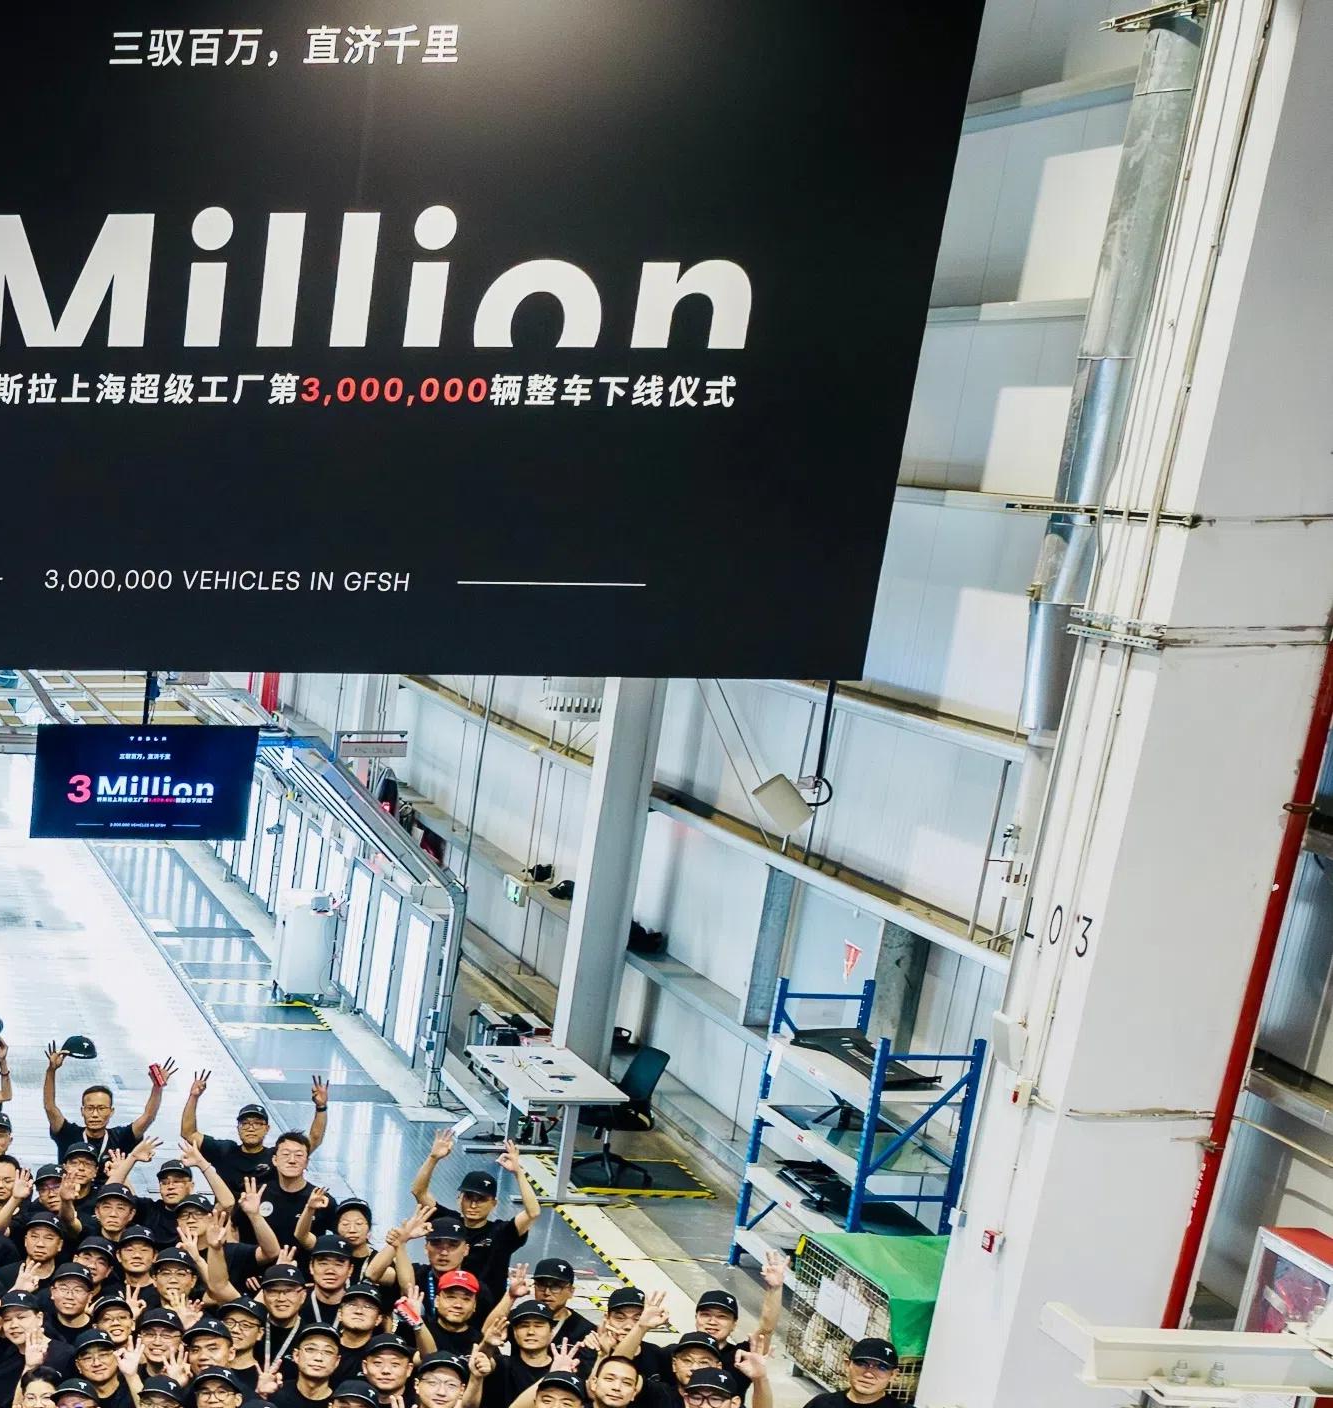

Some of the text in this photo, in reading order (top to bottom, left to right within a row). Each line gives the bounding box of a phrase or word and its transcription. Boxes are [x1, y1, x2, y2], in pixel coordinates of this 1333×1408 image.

[109, 23, 460, 67] 三驭百万，直济千里
[44, 569, 410, 592] 3,000,000 VEHICLES IN GFSH
[67, 774, 215, 803] 3 Million
